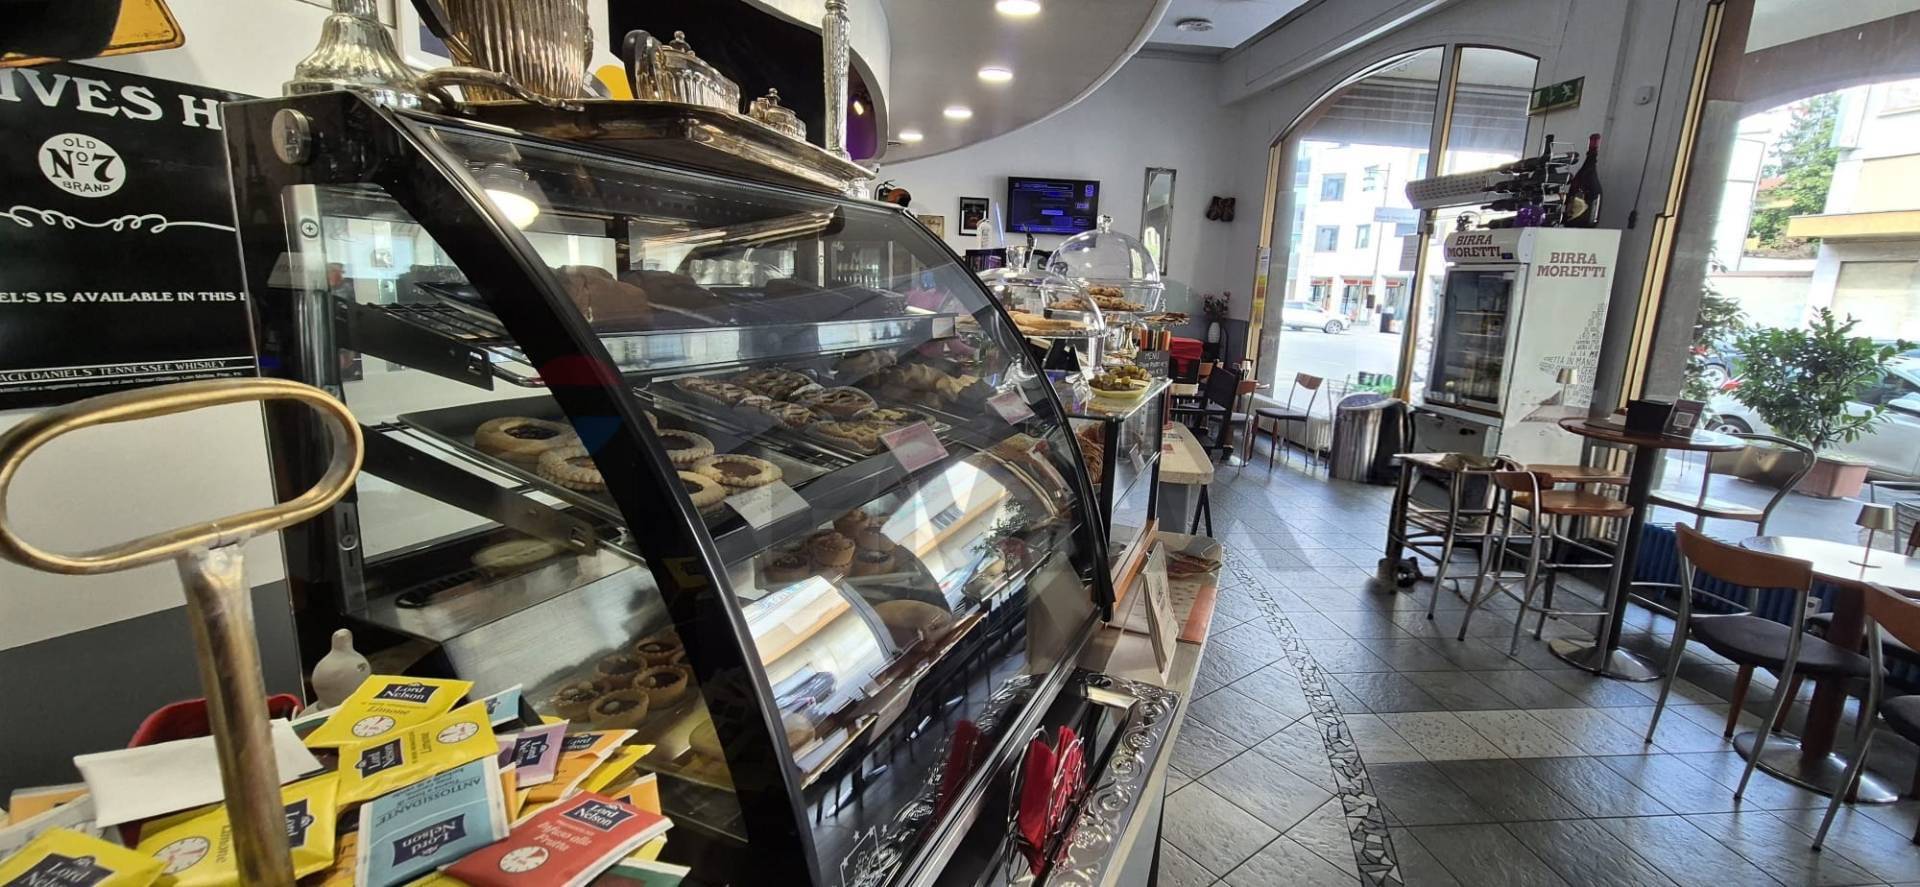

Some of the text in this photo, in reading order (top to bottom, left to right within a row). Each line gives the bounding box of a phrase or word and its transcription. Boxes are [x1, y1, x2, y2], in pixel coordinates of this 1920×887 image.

[63, 137, 97, 150] OLD
[62, 181, 111, 193] BRAND
[1455, 233, 1494, 246] BIRRA
[1446, 246, 1501, 259] MORETTI
[1550, 252, 1597, 265] BIRRA
[1536, 264, 1606, 278] MORETTI
[46, 291, 67, 303] IS
[72, 291, 174, 302] AVAILABLE
[178, 291, 194, 302] IN
[198, 291, 237, 302] THIS
[99, 361, 169, 377] TENNESSEE
[175, 359, 226, 371] WHISKEY
[383, 689, 426, 701] Nelson
[395, 684, 426, 694] Lord
[375, 776, 482, 828] ANTIOSSIDANTE
[573, 807, 613, 827] Nelson
[587, 803, 619, 819] Lord
[401, 820, 457, 847] Nelson
[411, 830, 450, 855] Lord
[45, 861, 91, 883] Lord
